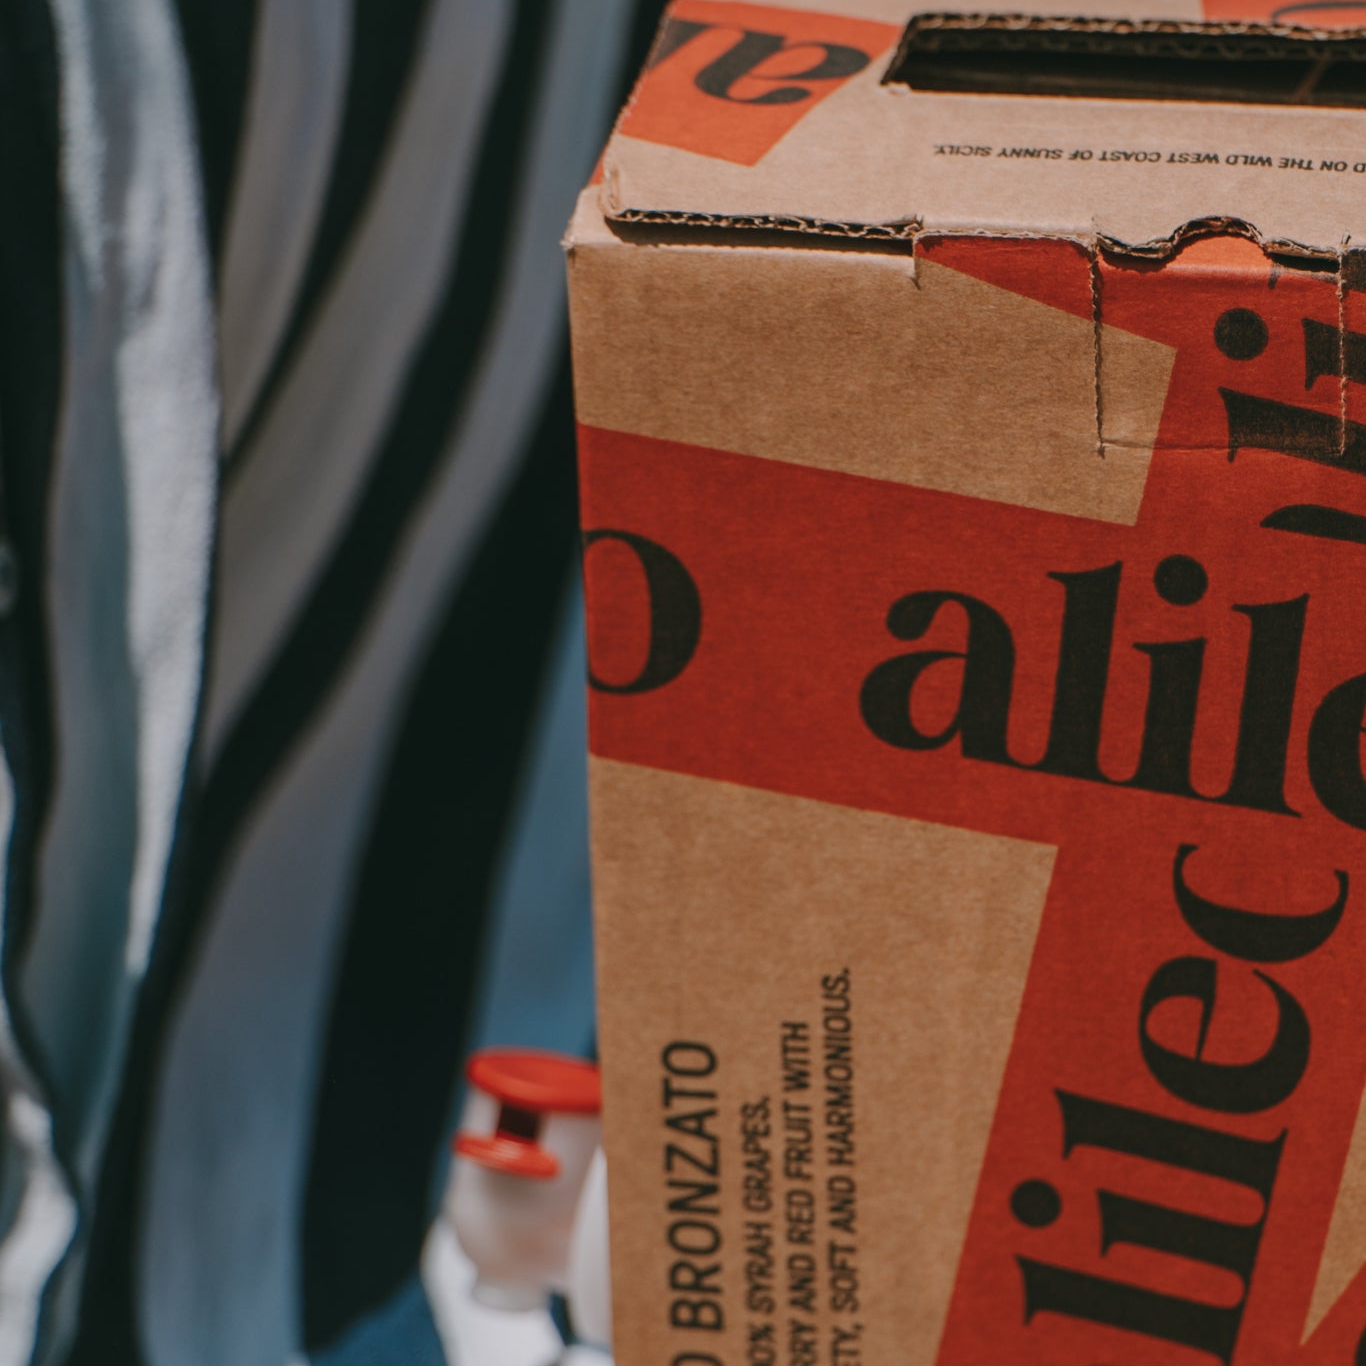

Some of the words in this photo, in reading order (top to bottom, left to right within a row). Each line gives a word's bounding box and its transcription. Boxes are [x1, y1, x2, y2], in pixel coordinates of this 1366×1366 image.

[997, 147, 1064, 160] SUNNY
[1068, 149, 1094, 161] OF
[1098, 150, 1162, 164] COAST
[1166, 152, 1220, 165] WEST
[1224, 154, 1273, 168] WILD
[1277, 157, 1314, 171] THE
[1319, 160, 1349, 172] ON
[782, 1022, 810, 1092] WITH
[821, 968, 854, 1166] HARMONIOUS.
[740, 1096, 773, 1213] GRAPES.
[782, 1101, 813, 1182] FRUIT
[661, 1041, 725, 1333] BRONZATO
[827, 1176, 856, 1234] AND
[786, 1190, 814, 1245] RED
[745, 1222, 775, 1315] SYRAH
[787, 1254, 816, 1313] AND
[828, 1241, 859, 1313] SOFT
